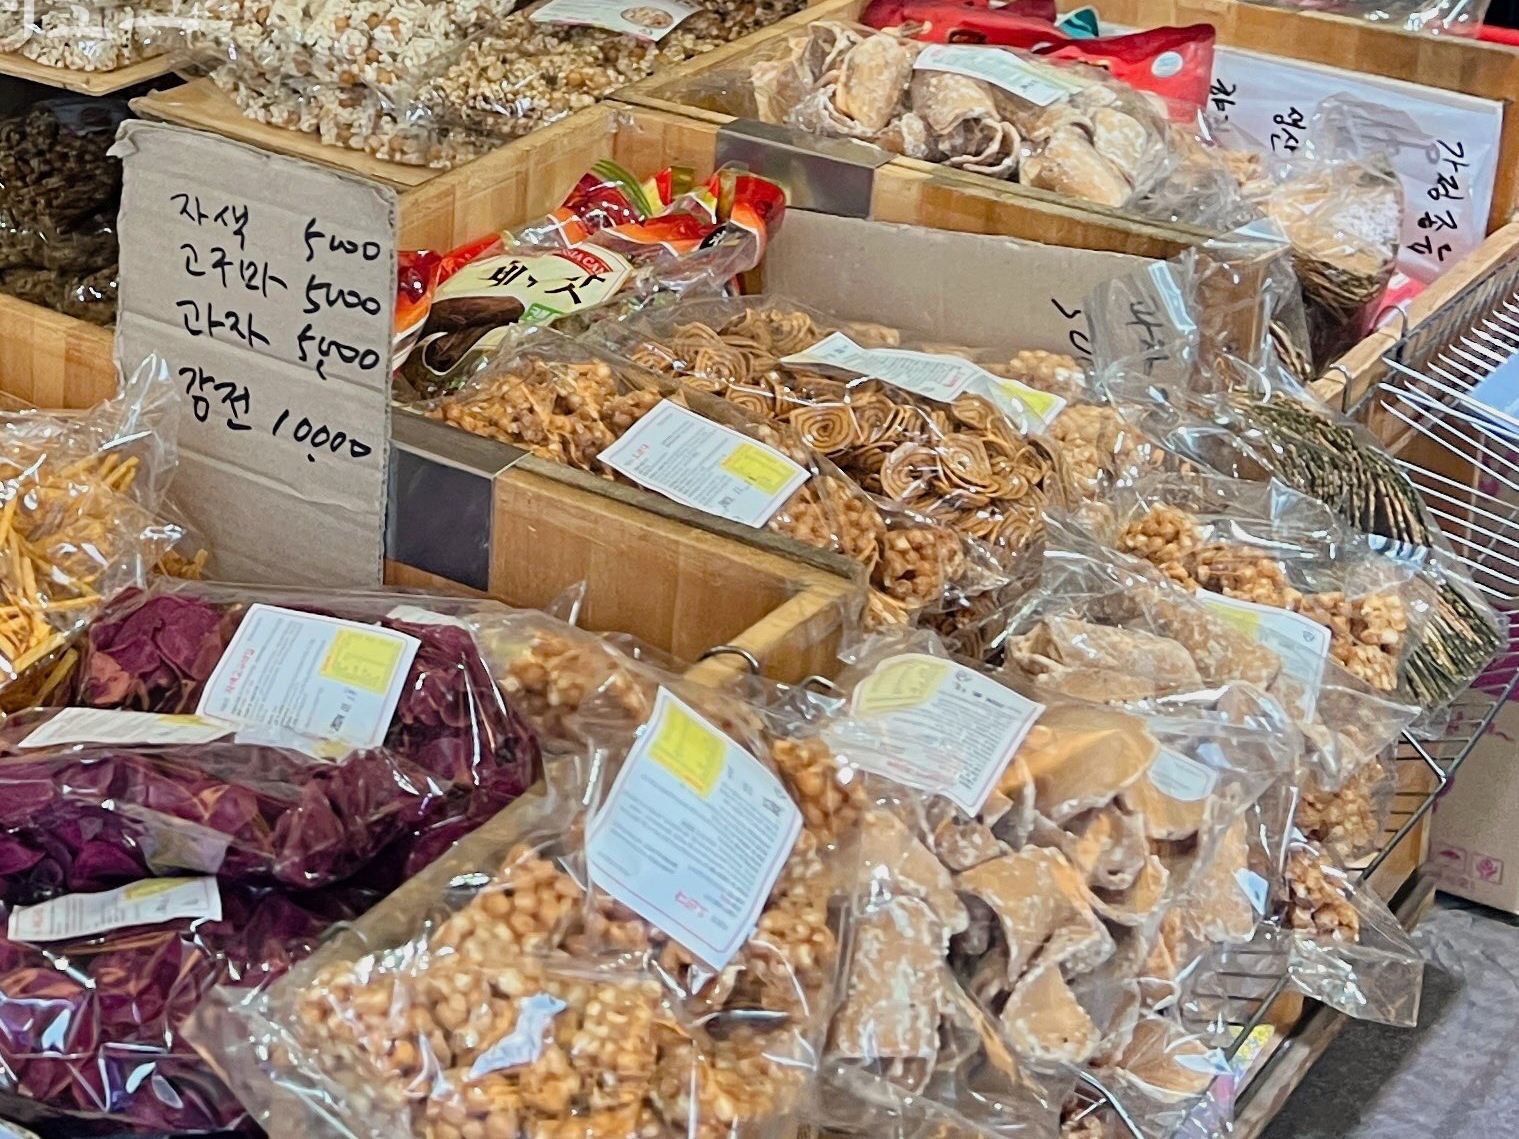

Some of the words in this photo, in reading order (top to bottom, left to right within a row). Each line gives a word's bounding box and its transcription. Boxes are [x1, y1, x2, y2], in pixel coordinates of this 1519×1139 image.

[170, 193, 250, 249] 자색
[179, 243, 288, 298] 고구마
[176, 299, 270, 349] 과자
